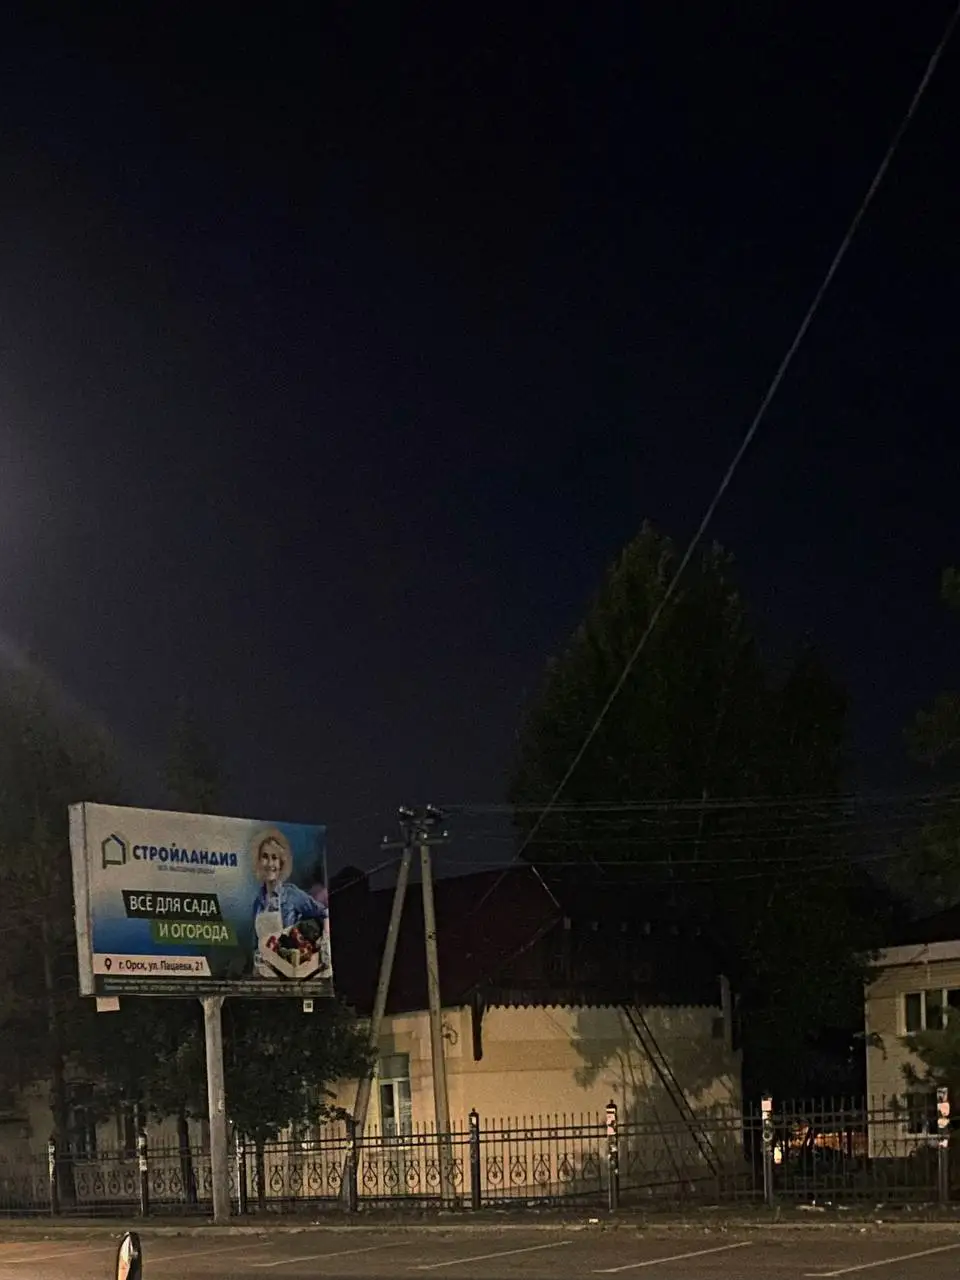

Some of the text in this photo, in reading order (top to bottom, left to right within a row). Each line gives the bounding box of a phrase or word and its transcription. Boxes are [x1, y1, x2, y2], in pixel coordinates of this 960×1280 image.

[132, 843, 238, 867] СТРОЙЛАНДИЯ
[130, 893, 218, 916] ВСЁ ДЛЯ САДА
[159, 923, 229, 942] И ОГОРОДА
[194, 961, 204, 971] 21
